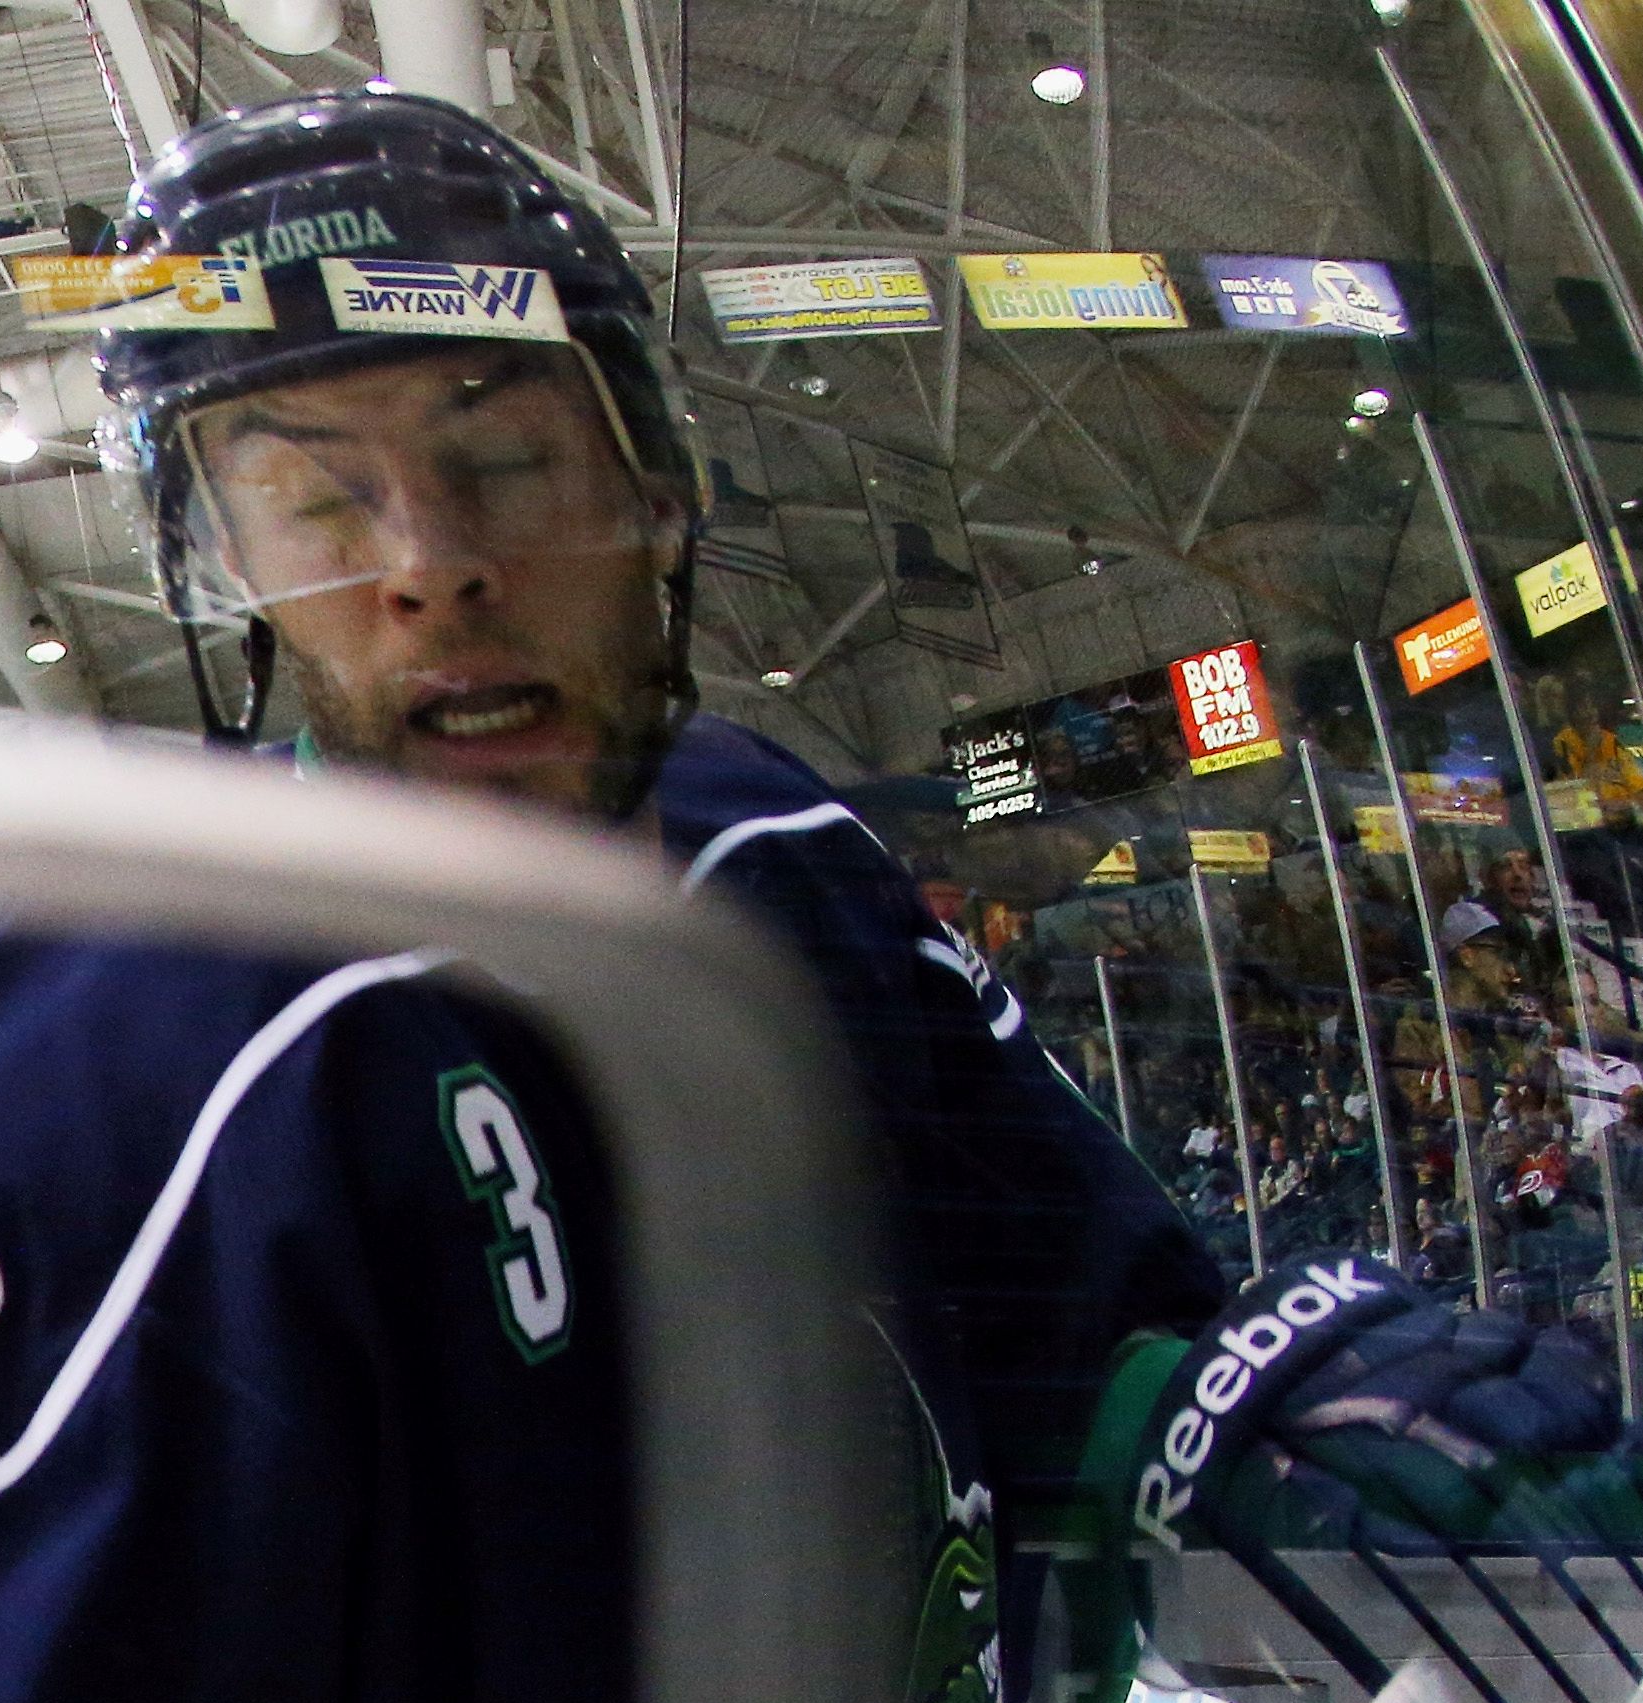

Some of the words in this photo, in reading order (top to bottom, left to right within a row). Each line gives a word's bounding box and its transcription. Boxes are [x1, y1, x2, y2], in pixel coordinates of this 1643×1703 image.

[220, 207, 396, 268] FLORIDA
[1530, 572, 1589, 615] valpak
[1181, 648, 1248, 699] BOB
[1190, 685, 1253, 725] FM
[1198, 714, 1261, 751] 102.9
[967, 758, 1019, 782] Cleaning
[970, 773, 1021, 796] Services
[437, 1062, 578, 1366] 3
[1134, 1258, 1387, 1553] Reebok
